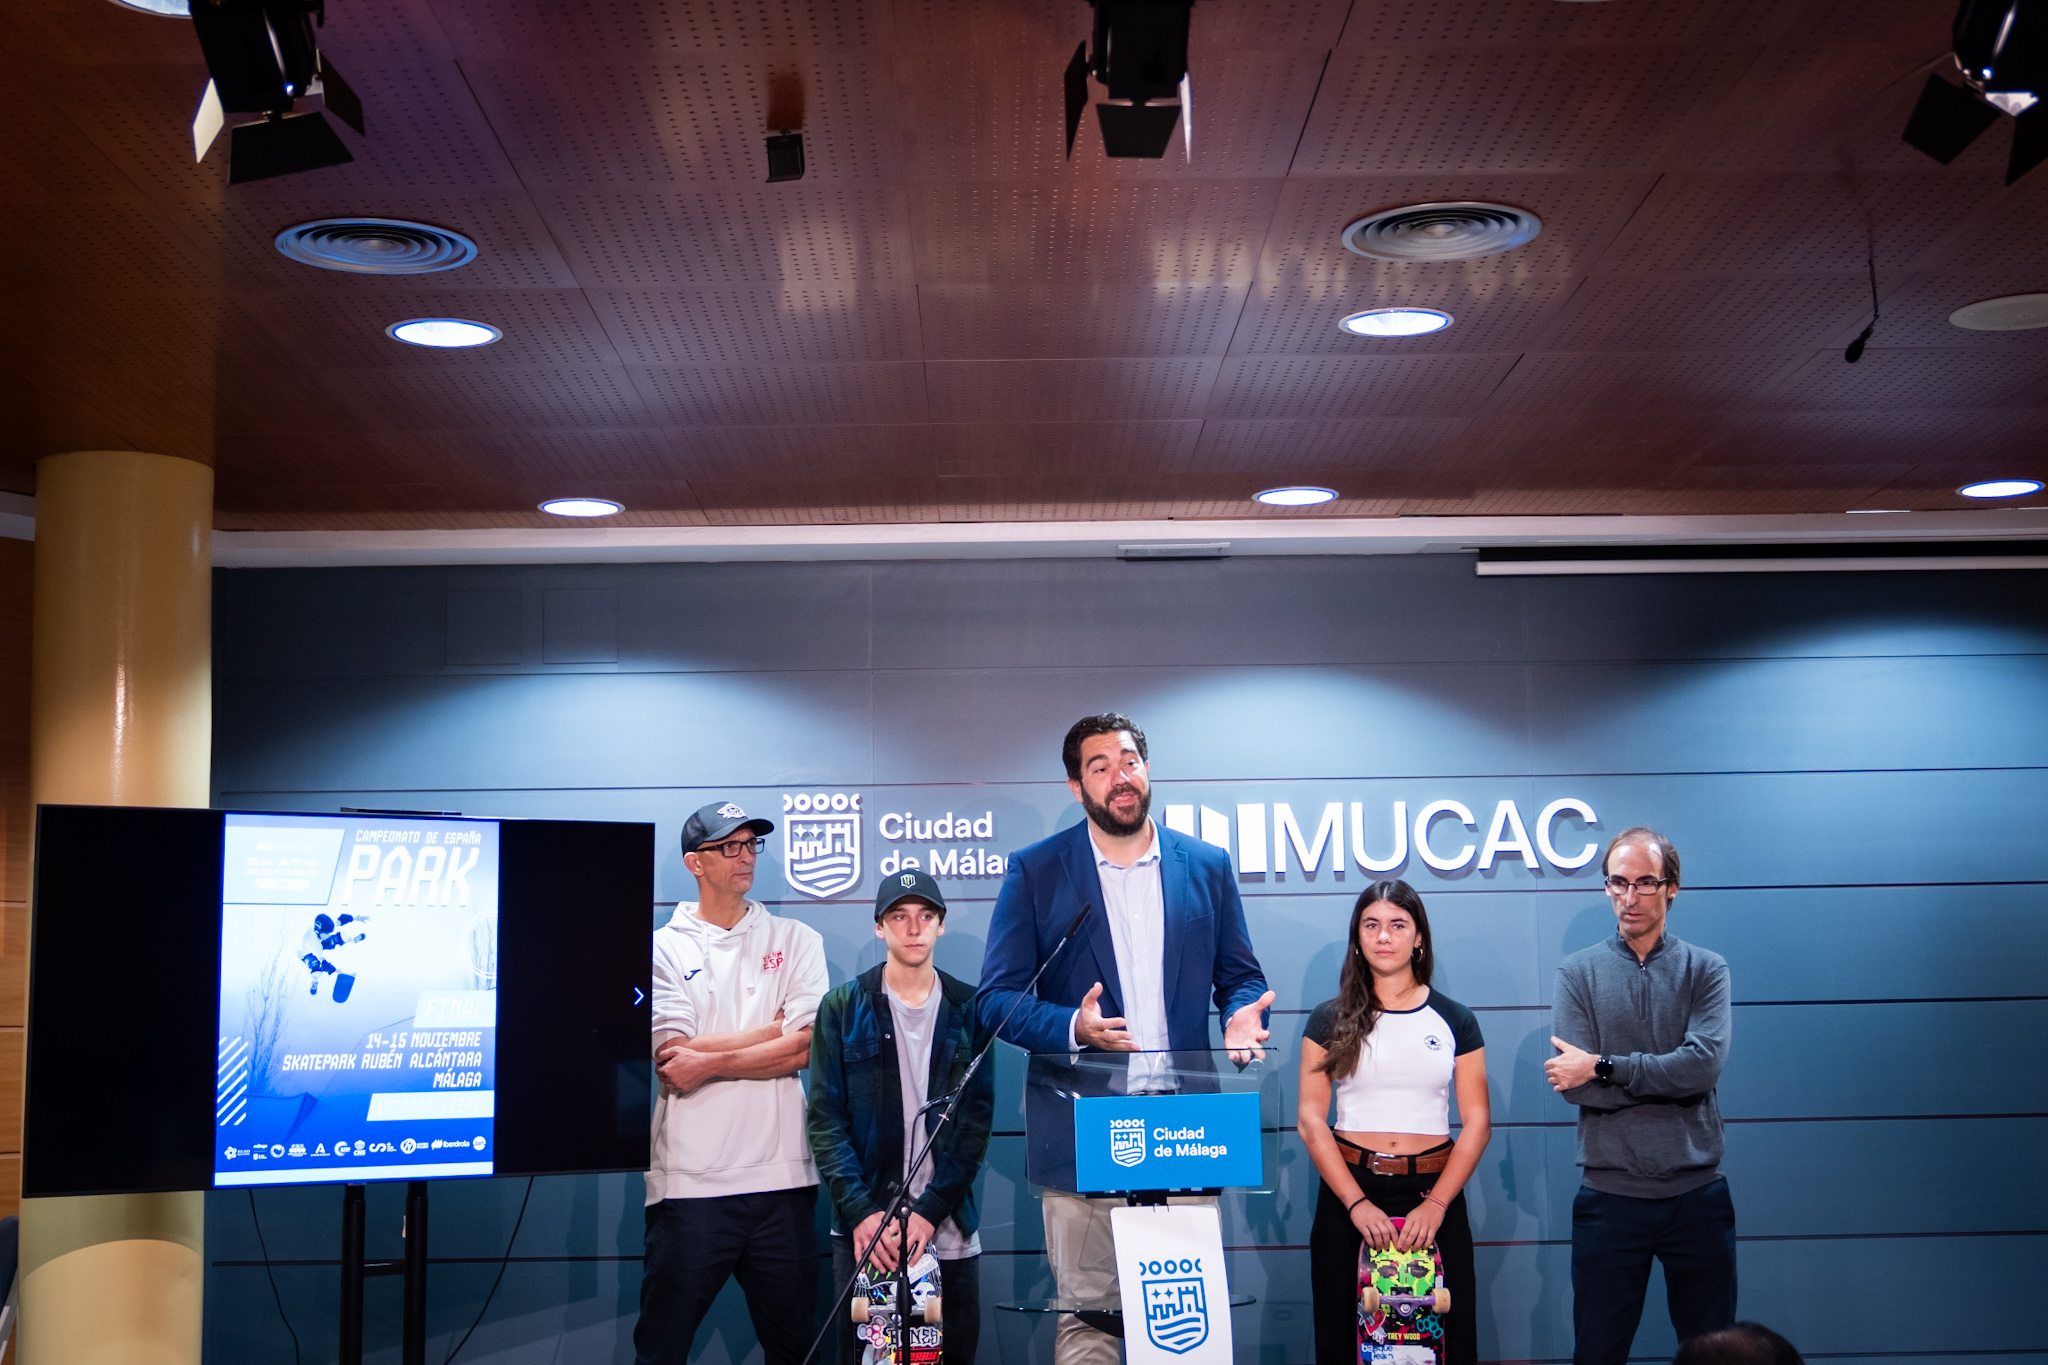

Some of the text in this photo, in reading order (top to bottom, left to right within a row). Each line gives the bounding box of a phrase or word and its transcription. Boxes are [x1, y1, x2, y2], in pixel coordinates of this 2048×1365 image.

[879, 811, 993, 840] Ciudad
[355, 829, 482, 845] CAMPEONATO DE ESPAÑA
[1273, 798, 1599, 873] MUCAC
[880, 848, 1009, 877] de Mála
[341, 844, 481, 907] PARK
[763, 957, 784, 971] ESP
[424, 997, 483, 1020] FINAL
[366, 1031, 482, 1049] 14-15 NOVIEMBRE
[282, 1048, 482, 1071] SKATEPARK RUBÉN ALCÁNTARA
[433, 1068, 482, 1088] MÁLAGA
[376, 1097, 481, 1115] ENTRADA LIBRE
[1153, 1126, 1205, 1141] Ciudad
[1154, 1143, 1228, 1159] de Málaga
[887, 1328, 939, 1346] BNES
[1387, 1332, 1421, 1340] TREY WOOD
